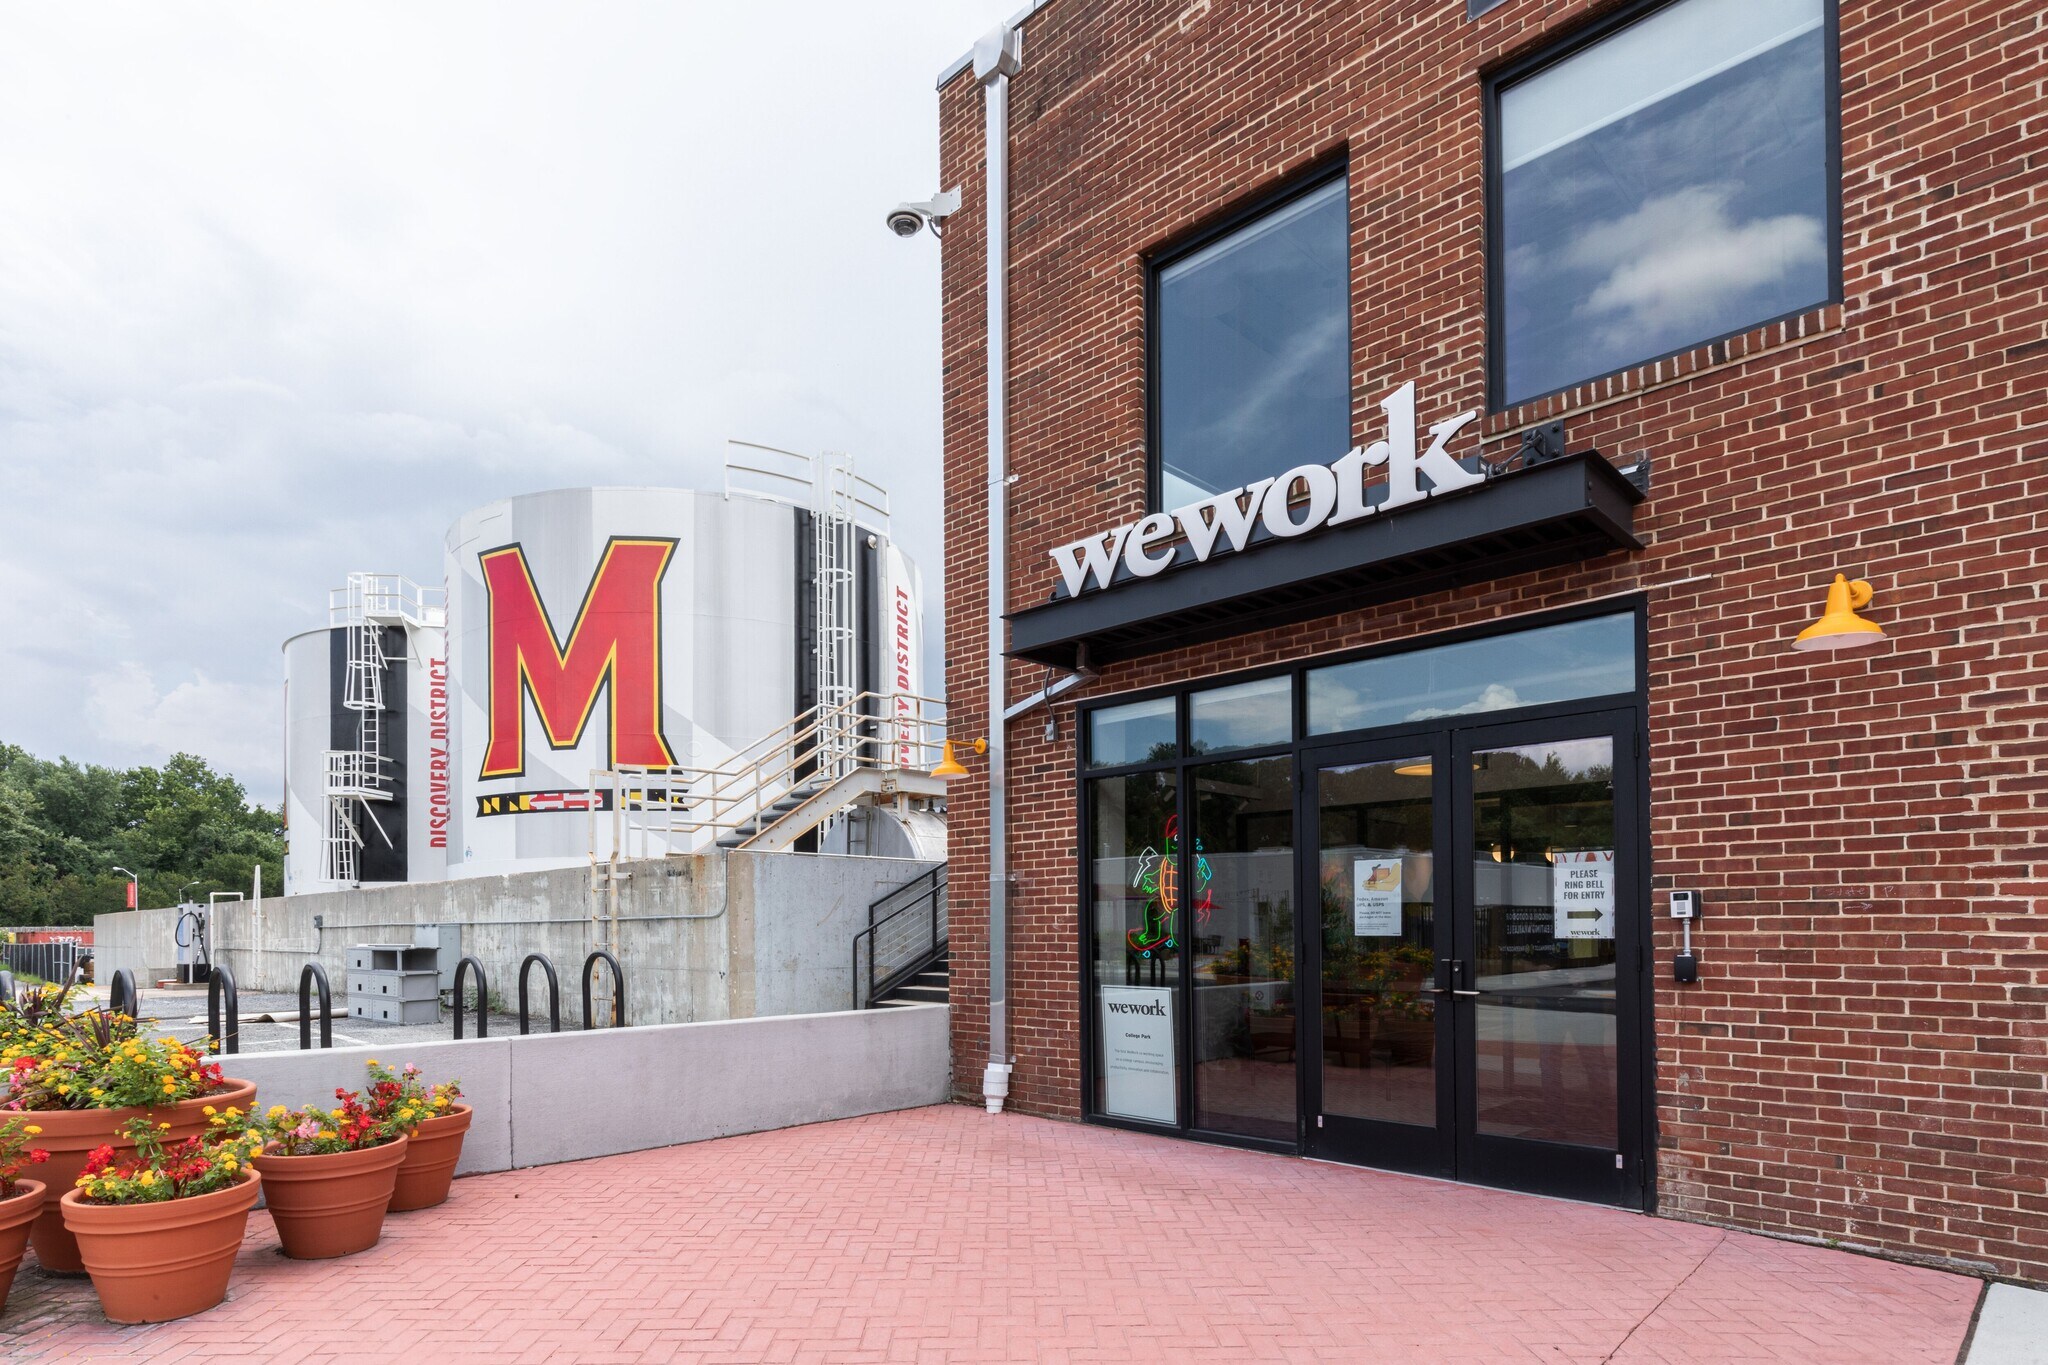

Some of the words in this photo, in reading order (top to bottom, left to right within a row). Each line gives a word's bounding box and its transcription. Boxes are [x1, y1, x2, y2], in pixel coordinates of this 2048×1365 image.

[1049, 381, 1486, 598] wework
[478, 535, 683, 782] M
[896, 585, 909, 691] DISTRICT
[430, 657, 446, 740] DISTRICT
[430, 746, 446, 848] DISCOVERY
[1564, 880, 1584, 889] RING
[1586, 880, 1604, 888] BELL
[1564, 892, 1578, 900] FOR
[1581, 890, 1605, 900] ENTRY
[1570, 870, 1598, 878] PLEASE
[1108, 999, 1166, 1016] wework
